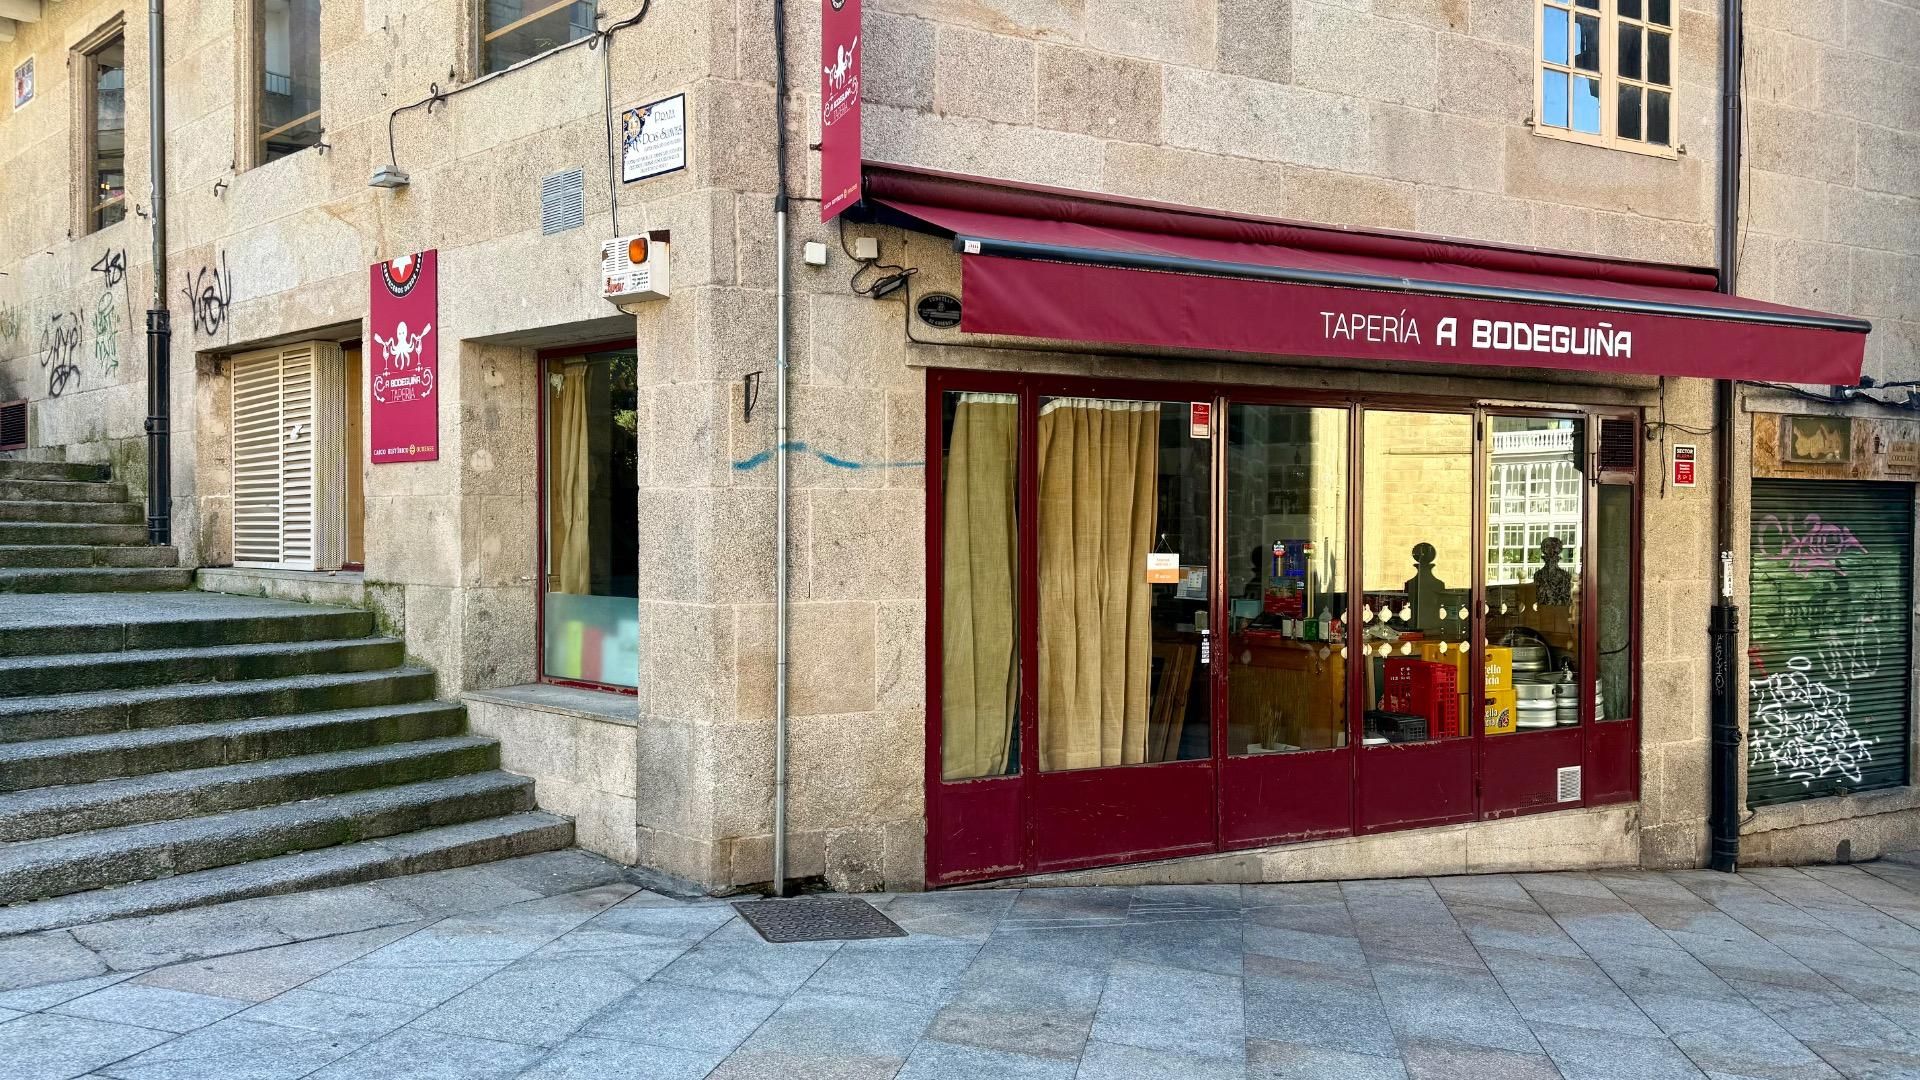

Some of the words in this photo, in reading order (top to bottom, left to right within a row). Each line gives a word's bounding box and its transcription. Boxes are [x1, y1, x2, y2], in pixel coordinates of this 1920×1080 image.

[1320, 308, 1421, 345] TAPERÍA
[1436, 317, 1458, 347] A
[1472, 317, 1632, 359] BODEGUIÑA
[390, 374, 421, 388] BODEGUIÑA
